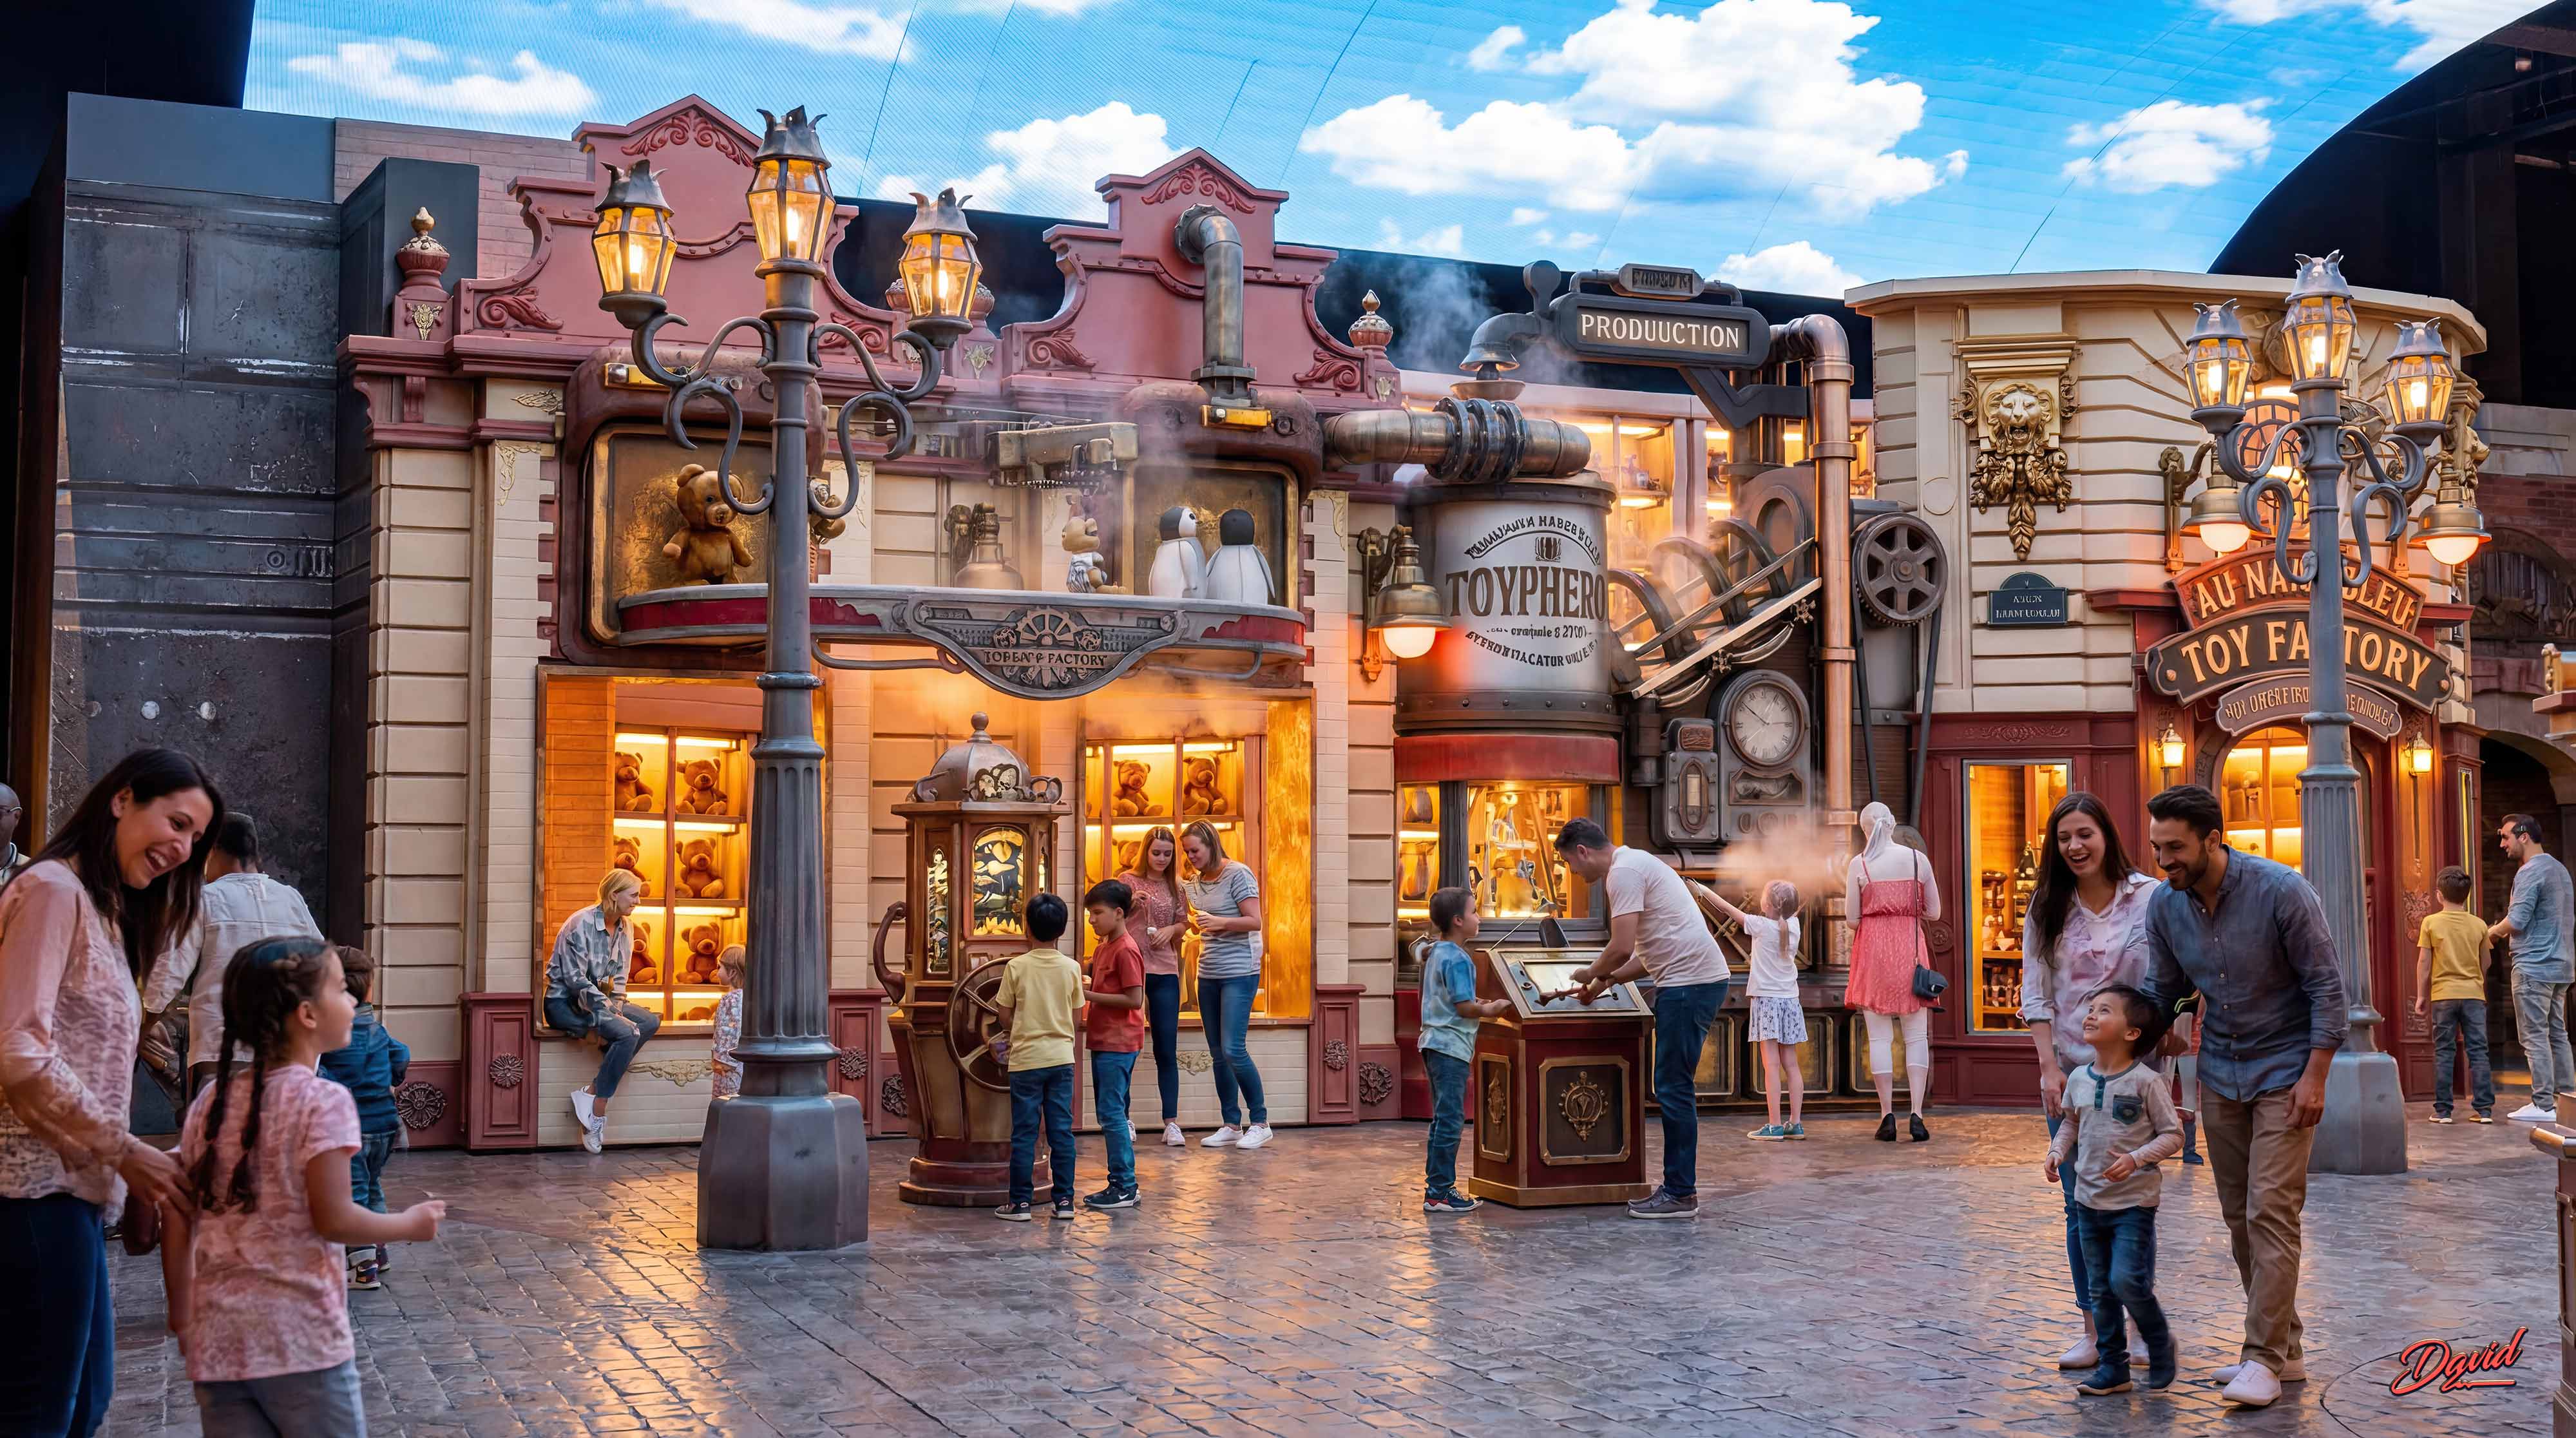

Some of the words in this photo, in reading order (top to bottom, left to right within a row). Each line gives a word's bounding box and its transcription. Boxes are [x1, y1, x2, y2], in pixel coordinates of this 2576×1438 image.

[1581, 314, 1740, 349] PRODUUCTION
[1445, 565, 1606, 622] TOYPHERO
[2196, 571, 2235, 619] AU
[1048, 653, 1107, 666] FACTORY
[2180, 624, 2250, 684] TOY
[2266, 618, 2432, 692] FATORY
